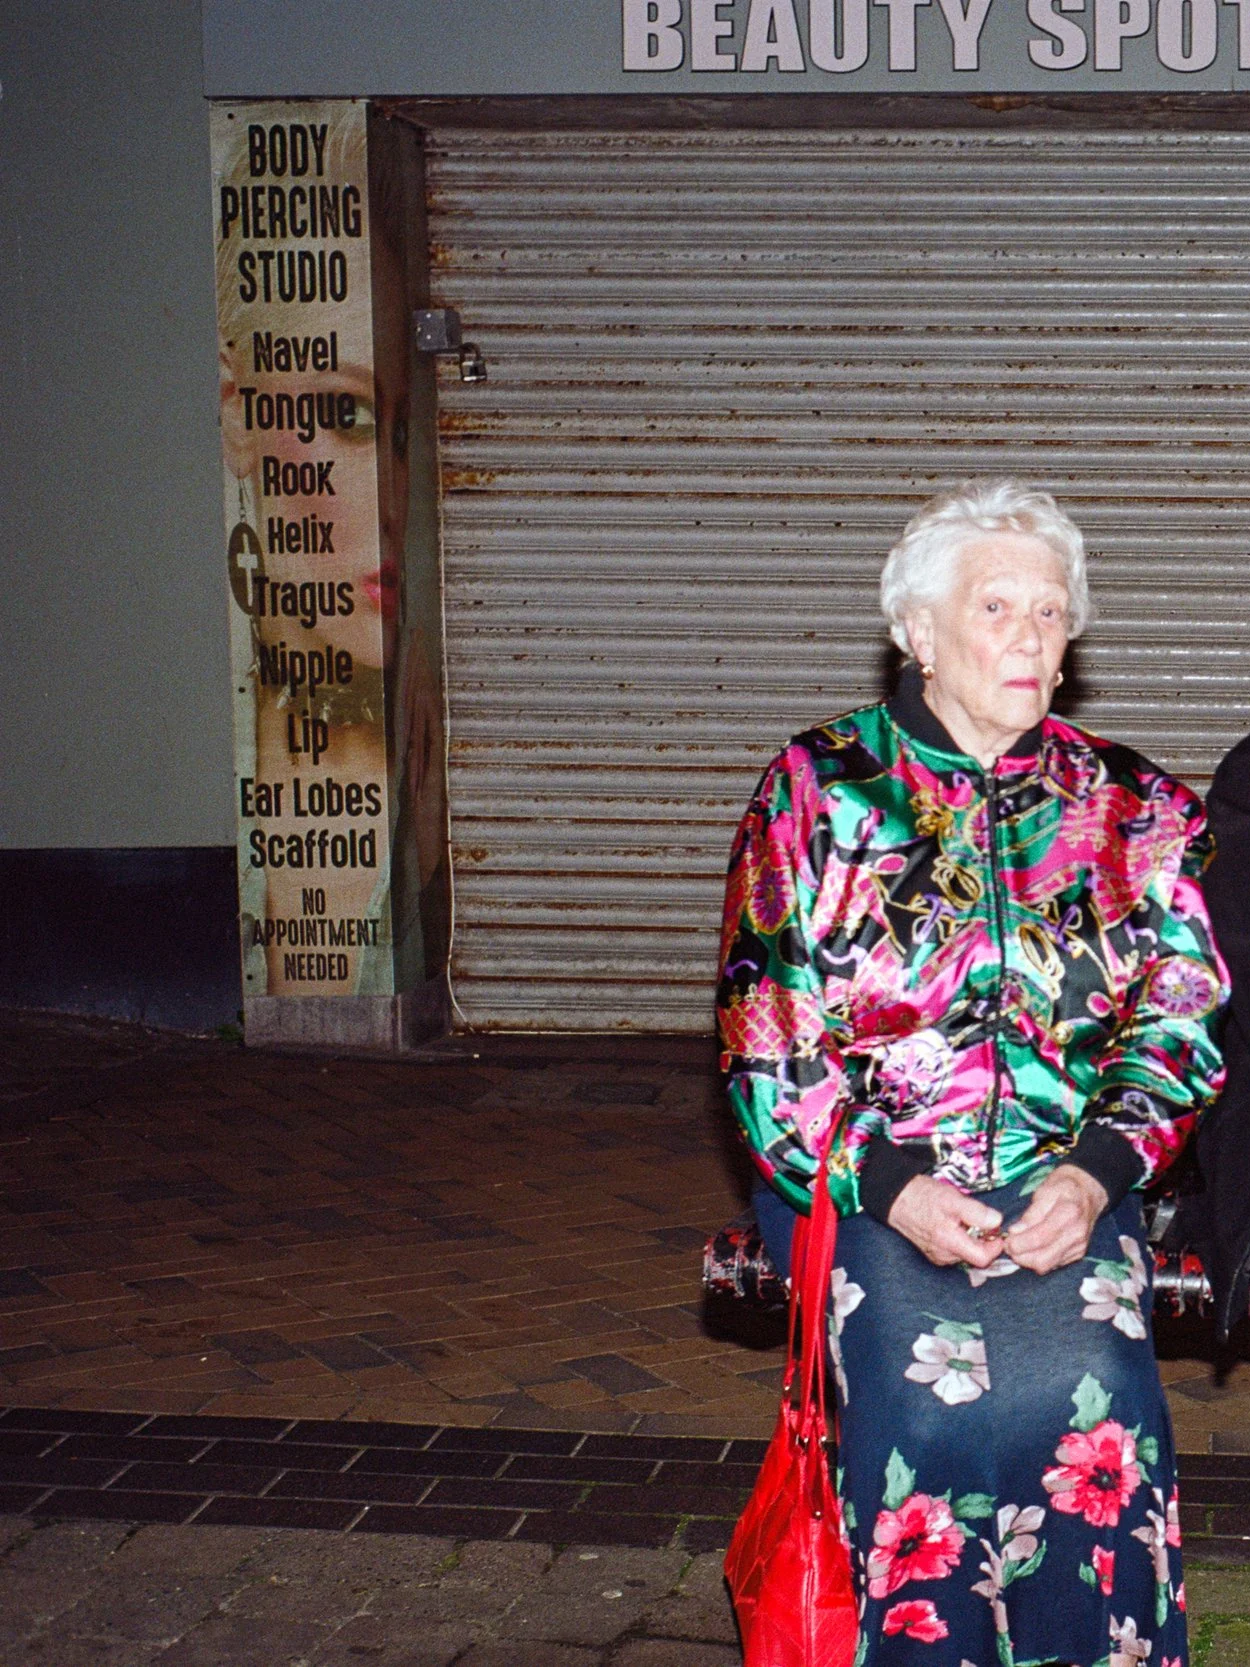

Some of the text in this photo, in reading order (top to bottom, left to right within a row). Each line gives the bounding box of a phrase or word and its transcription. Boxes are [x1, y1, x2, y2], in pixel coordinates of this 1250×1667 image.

[622, 0, 993, 73] BEAUTY
[248, 124, 328, 177] BODY
[221, 186, 362, 239] PIERCING
[238, 251, 347, 303] STUDIO
[253, 331, 337, 372] Navel
[239, 387, 356, 444] Tongue
[268, 514, 334, 554] Helix
[254, 576, 354, 629] Tragus
[259, 645, 352, 698] Nipple
[288, 713, 328, 765] Lip
[241, 777, 381, 818] Ear Lobes
[250, 829, 376, 868] Scaffold
[302, 888, 325, 915] NO
[253, 919, 379, 947] APPOINTMENT
[285, 953, 348, 982] NEEDED
